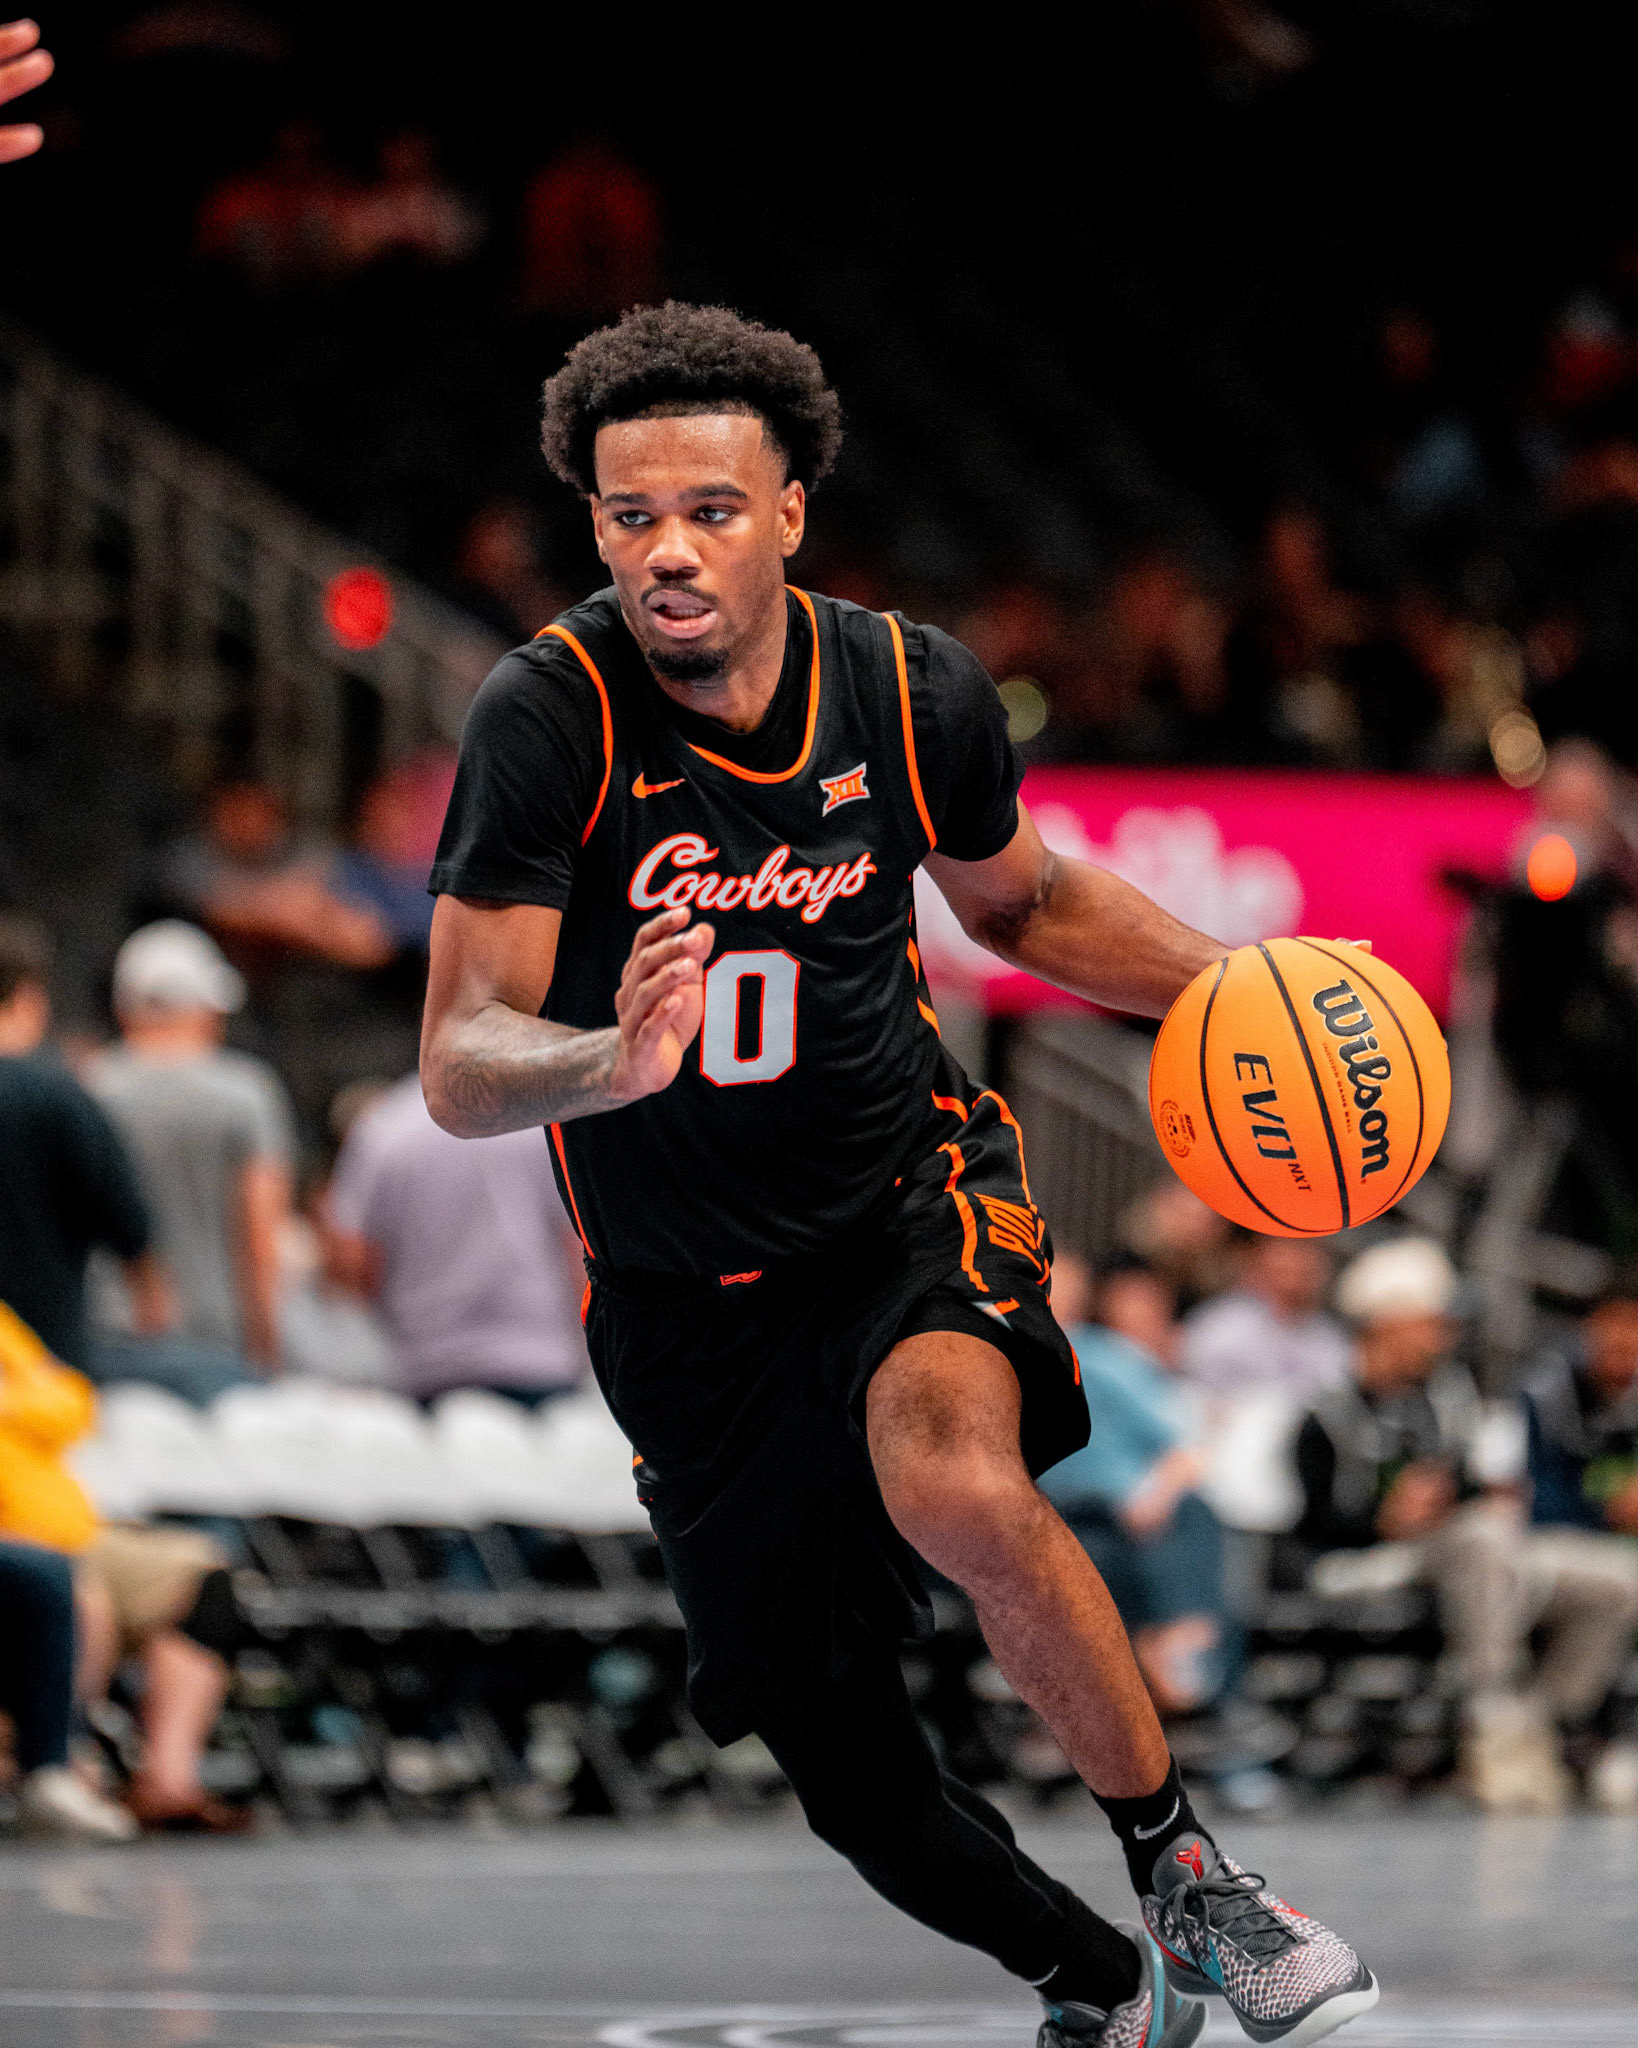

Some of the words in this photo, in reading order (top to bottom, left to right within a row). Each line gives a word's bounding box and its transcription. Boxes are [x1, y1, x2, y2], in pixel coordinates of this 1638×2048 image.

[822, 766, 869, 811] XII
[628, 832, 877, 924] Cowboys
[700, 949, 801, 1088] 0
[1312, 978, 1392, 1179] Wilson
[1233, 1052, 1297, 1160] EVO
[1287, 1163, 1312, 1193] NXT
